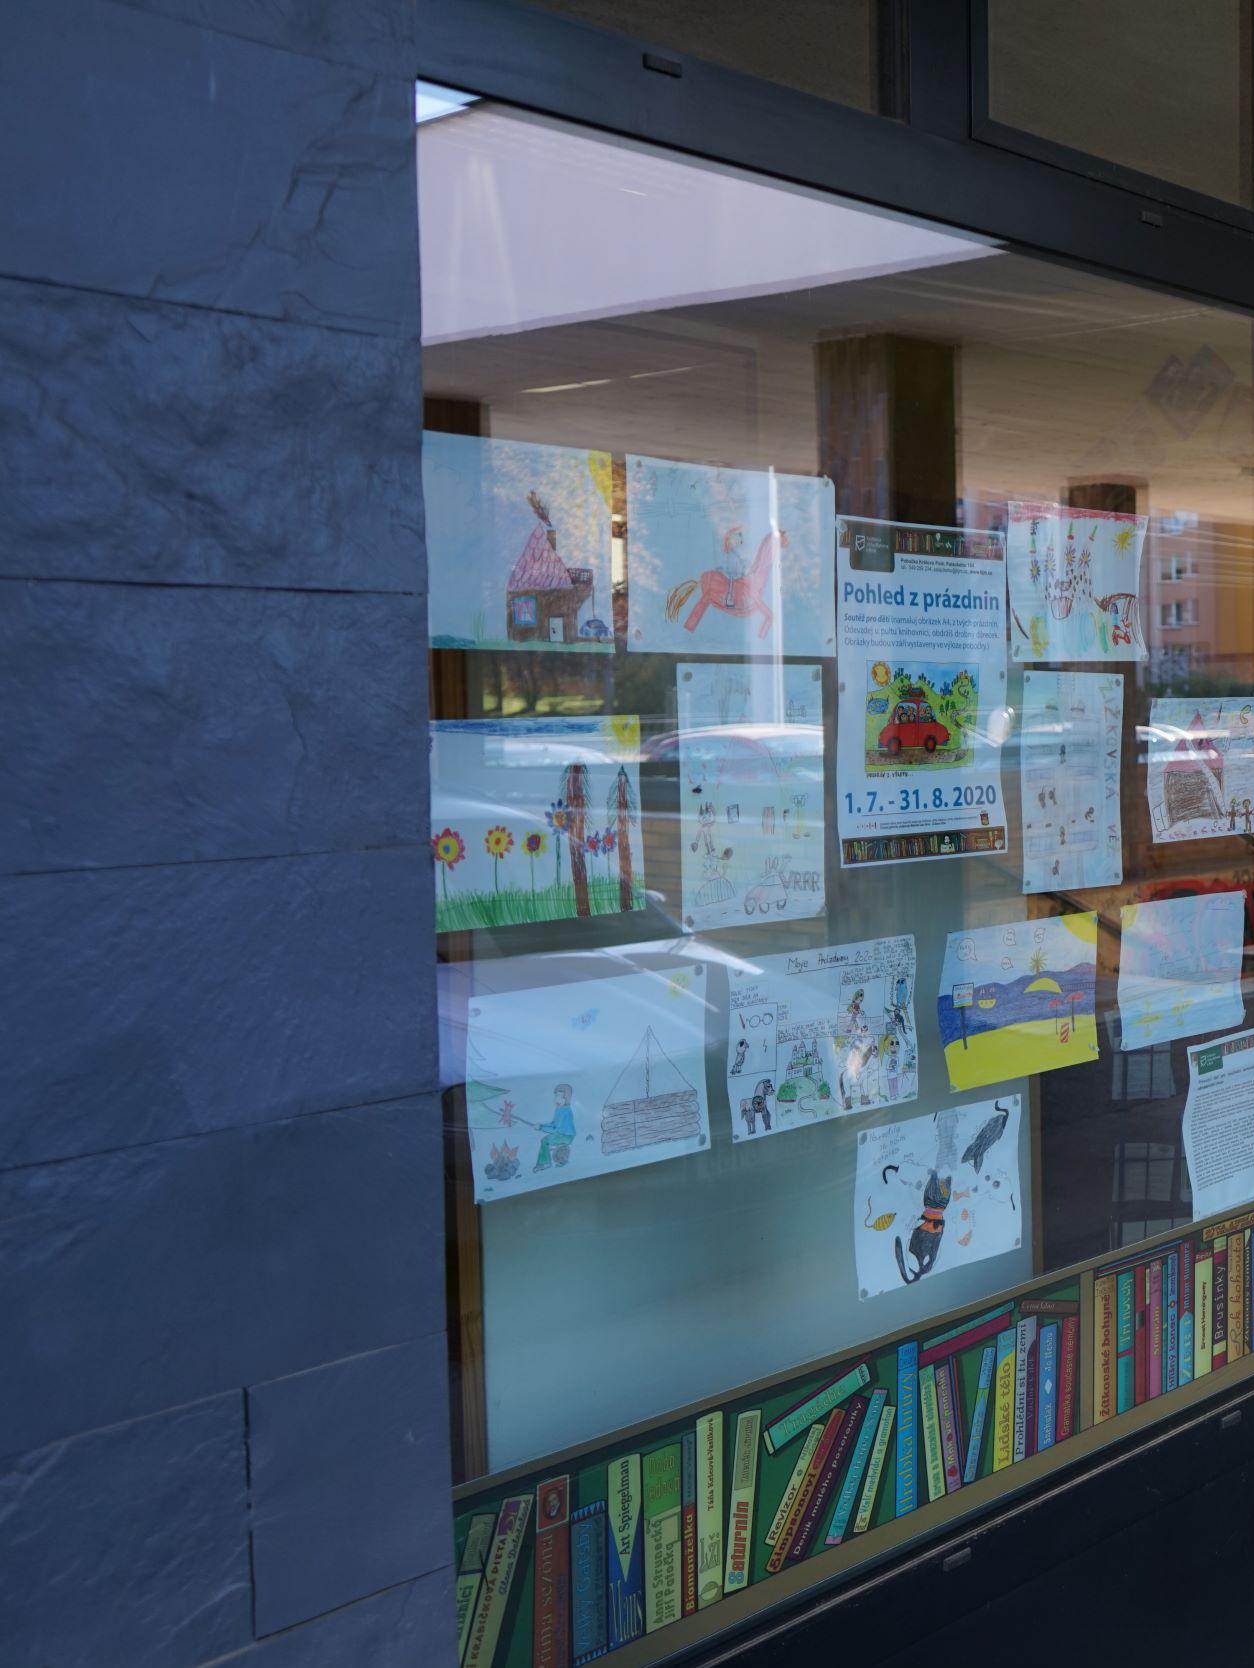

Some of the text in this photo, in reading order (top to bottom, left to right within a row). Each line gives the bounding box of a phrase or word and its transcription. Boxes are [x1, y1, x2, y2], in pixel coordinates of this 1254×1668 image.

[844, 582, 999, 613] Pohled z prázdnin
[953, 784, 996, 807] 2020
[1101, 1293, 1113, 1347] bohyně
[1214, 1264, 1226, 1341] Brusinky
[1229, 1236, 1243, 1357] Rok kohouta
[998, 1360, 1011, 1466] Lidské tělo
[1015, 1323, 1027, 1456] Prohlédni si tu zemi
[1060, 1394, 1074, 1436] Gramatika
[811, 1471, 833, 1517] malého
[831, 1402, 863, 1469] poseroutky
[898, 1435, 914, 1513] Hrobka
[617, 1459, 631, 1556] Art Spiegelman
[728, 1500, 750, 1585] Saturnin
[768, 1483, 798, 1541] Revizor
[769, 1472, 817, 1570] Simpsonovi
[576, 1521, 593, 1594] Gatsby
[664, 1541, 676, 1624] Jiří Patočka
[685, 1513, 696, 1612] Biomanželka
[538, 1612, 554, 1668] rima
[608, 1579, 645, 1643] Maus
[653, 1590, 664, 1625] Anna
